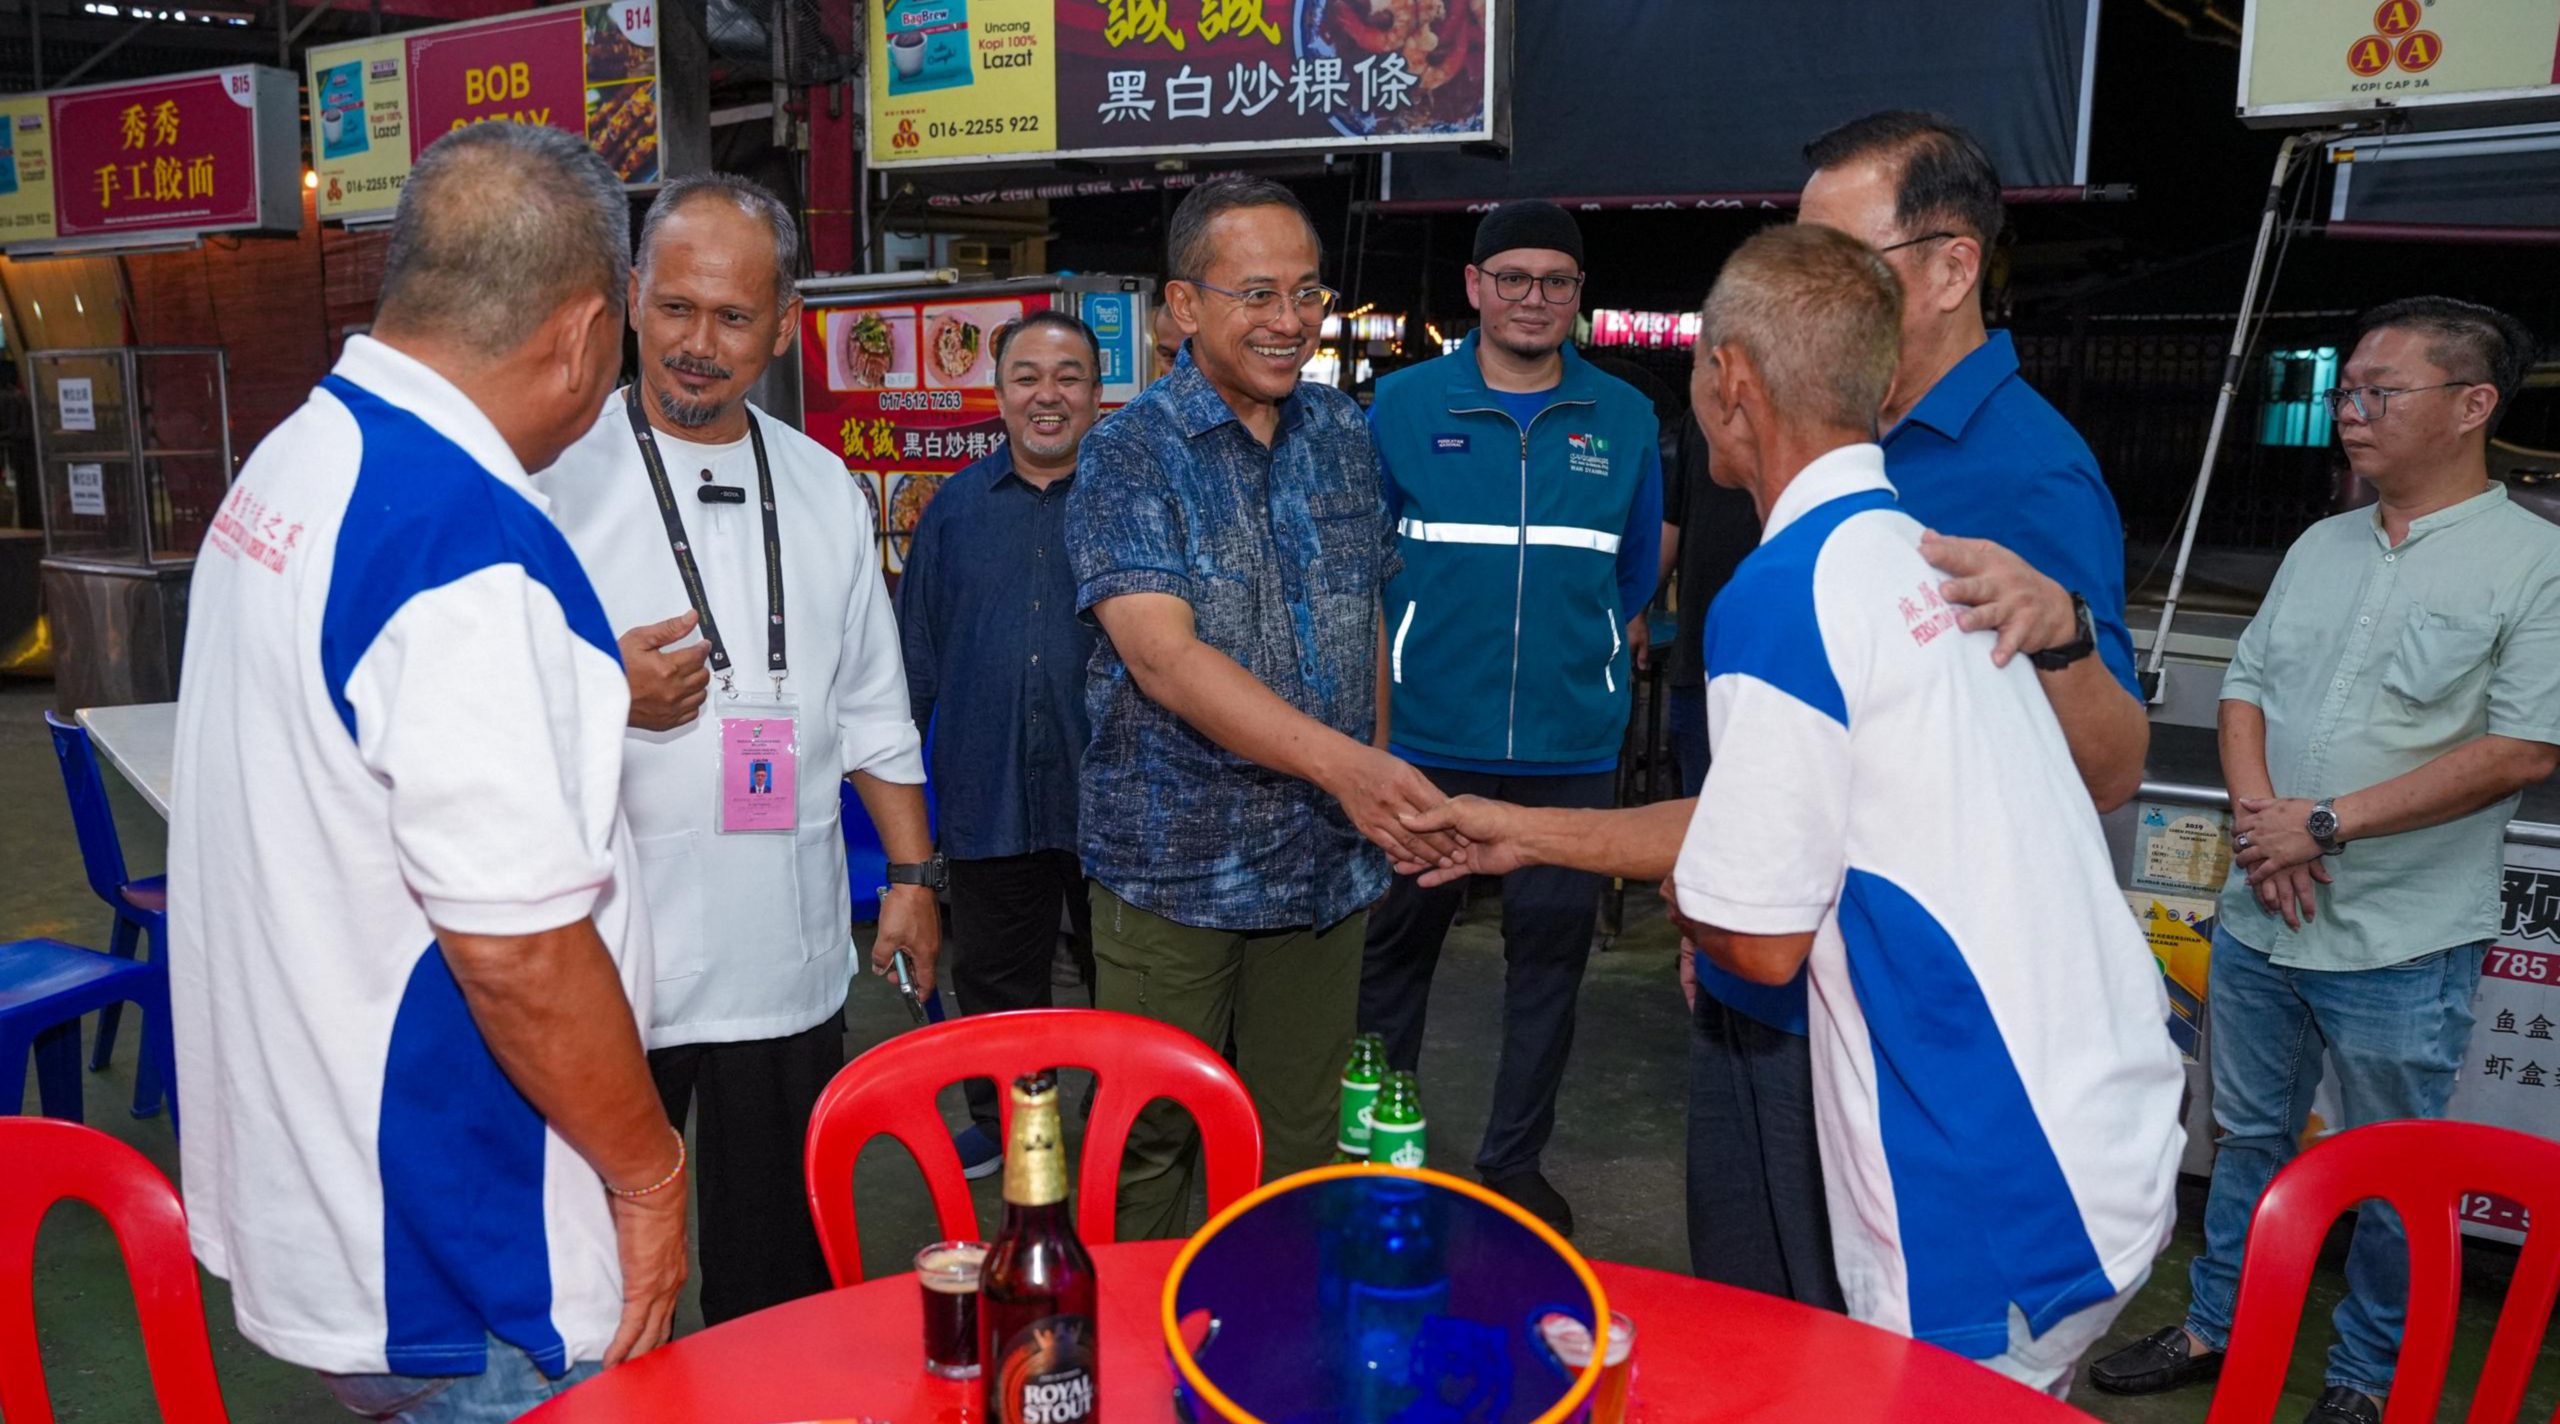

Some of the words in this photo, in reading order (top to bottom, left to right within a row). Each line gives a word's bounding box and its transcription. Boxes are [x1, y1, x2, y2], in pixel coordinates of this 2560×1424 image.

[626, 6, 651, 31] B14
[902, 9, 948, 26] BagBrew
[985, 21, 1031, 34] Uncang
[979, 38, 1004, 51] Kopi
[1008, 35, 1037, 48] 100%
[983, 49, 1033, 69] Lazat
[232, 75, 250, 94] B15
[465, 62, 531, 105] BOB
[1098, 52, 1419, 124] 黑白炒粿條
[2351, 82, 2381, 92] KOPI
[2385, 80, 2410, 90] CAP
[2414, 78, 2430, 88] 3A
[120, 100, 181, 150] 秀秀
[373, 124, 401, 139] Lazat
[929, 118, 1004, 139] 016-2255
[1009, 115, 1039, 132] 922
[93, 154, 215, 209] 手工餃面
[346, 177, 387, 194] 016-2255
[880, 392, 928, 410] 017-612
[930, 391, 962, 410] 7263
[840, 417, 900, 462] 誠誠
[2491, 950, 2548, 980] 785
[2489, 1008, 2557, 1041] 鱼盒
[2483, 1053, 2560, 1088] 虾盒
[1024, 1373, 1093, 1405] ROYAL
[1023, 1392, 1092, 1424] STOUT
